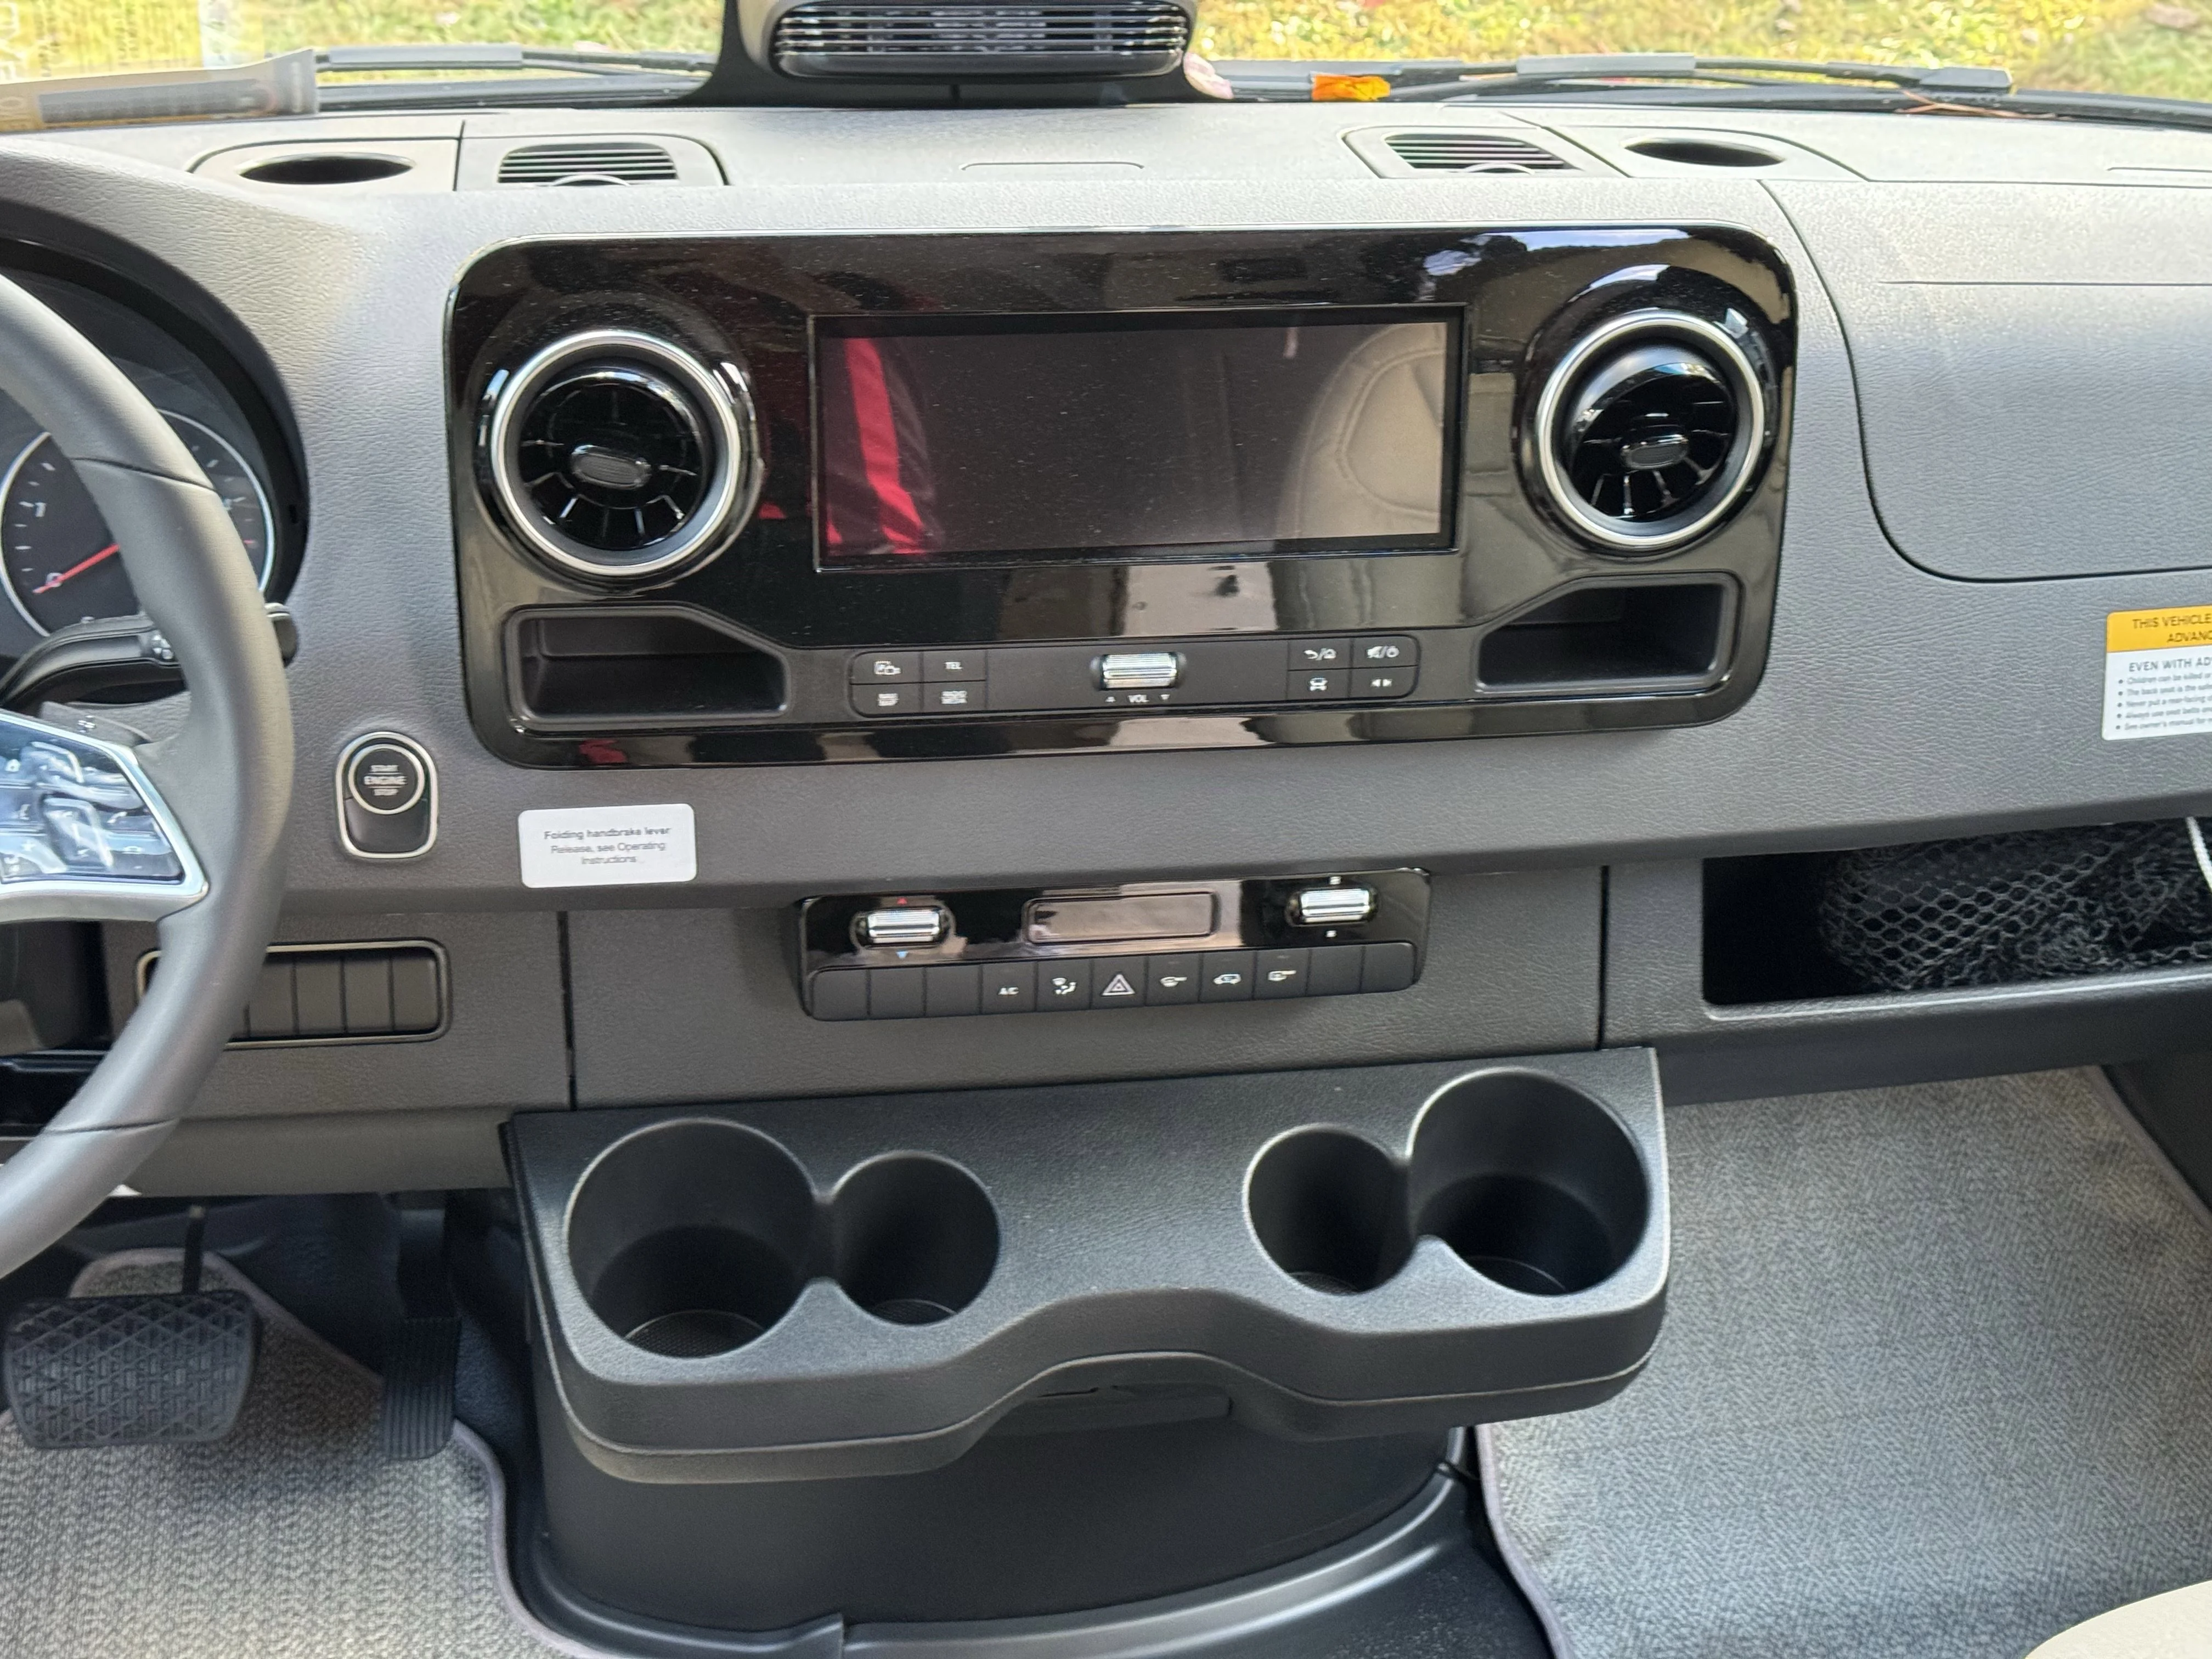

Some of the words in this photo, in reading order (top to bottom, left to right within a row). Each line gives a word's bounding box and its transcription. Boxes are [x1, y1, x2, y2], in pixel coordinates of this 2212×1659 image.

[35, 502, 47, 517] 1
[2132, 617, 2159, 629] THIS
[2162, 613, 2211, 627] VEHICLE
[2129, 661, 2158, 672] EVEN
[2162, 658, 2192, 669] WITH
[1127, 694, 1150, 703] VOL
[364, 776, 408, 785] ENGINE
[544, 830, 584, 840] Folding
[586, 828, 642, 837] handbrake
[644, 827, 672, 835] lever
[617, 842, 666, 852] Operating
